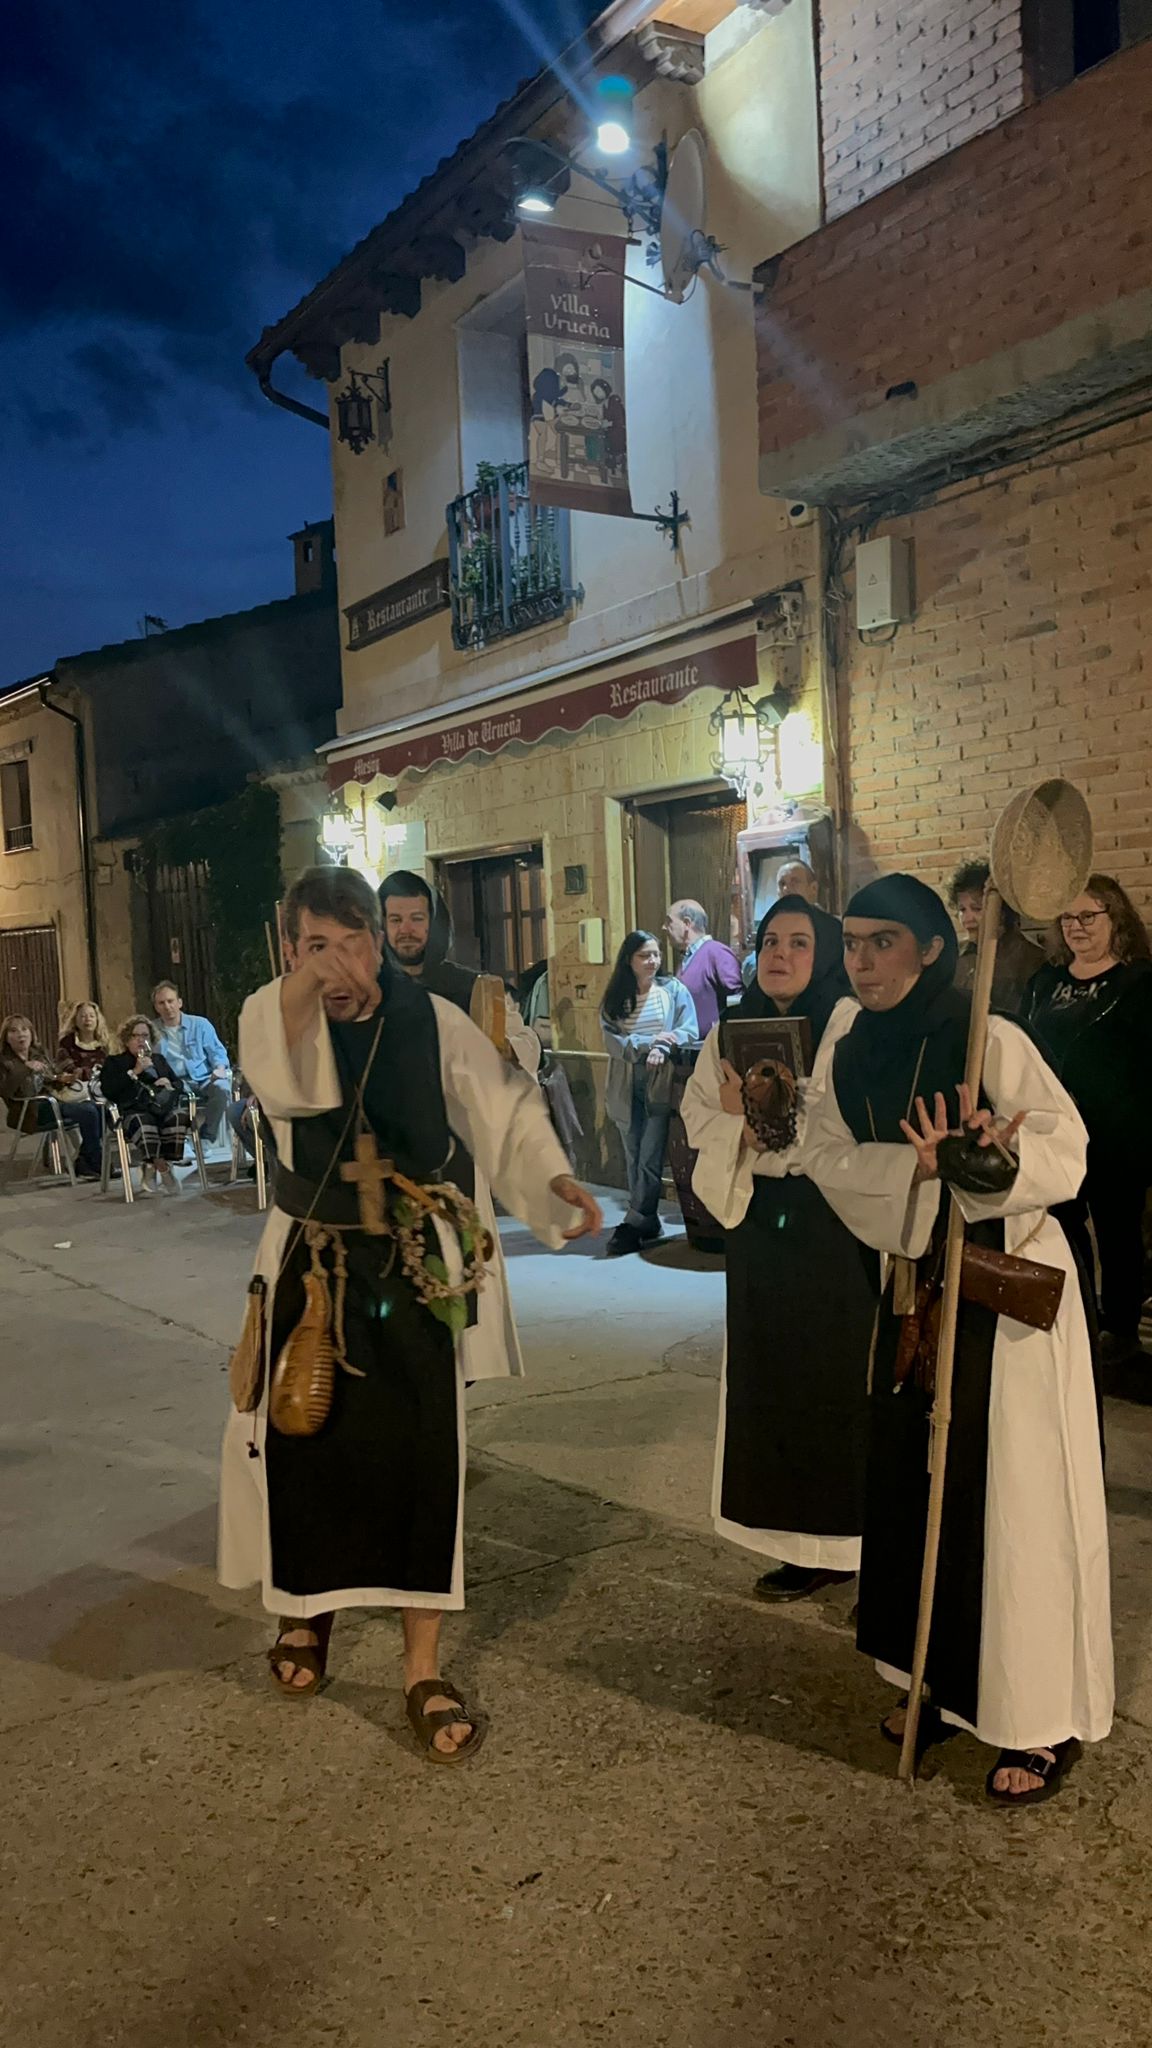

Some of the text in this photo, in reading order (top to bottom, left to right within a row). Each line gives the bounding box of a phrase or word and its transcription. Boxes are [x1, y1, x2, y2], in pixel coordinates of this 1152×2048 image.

[550, 293, 590, 316] Villa
[544, 312, 610, 339] Urueña
[367, 588, 430, 631] Restaurante
[441, 731, 465, 754] Villa
[467, 727, 479, 746] de
[609, 663, 699, 708] Restaurante
